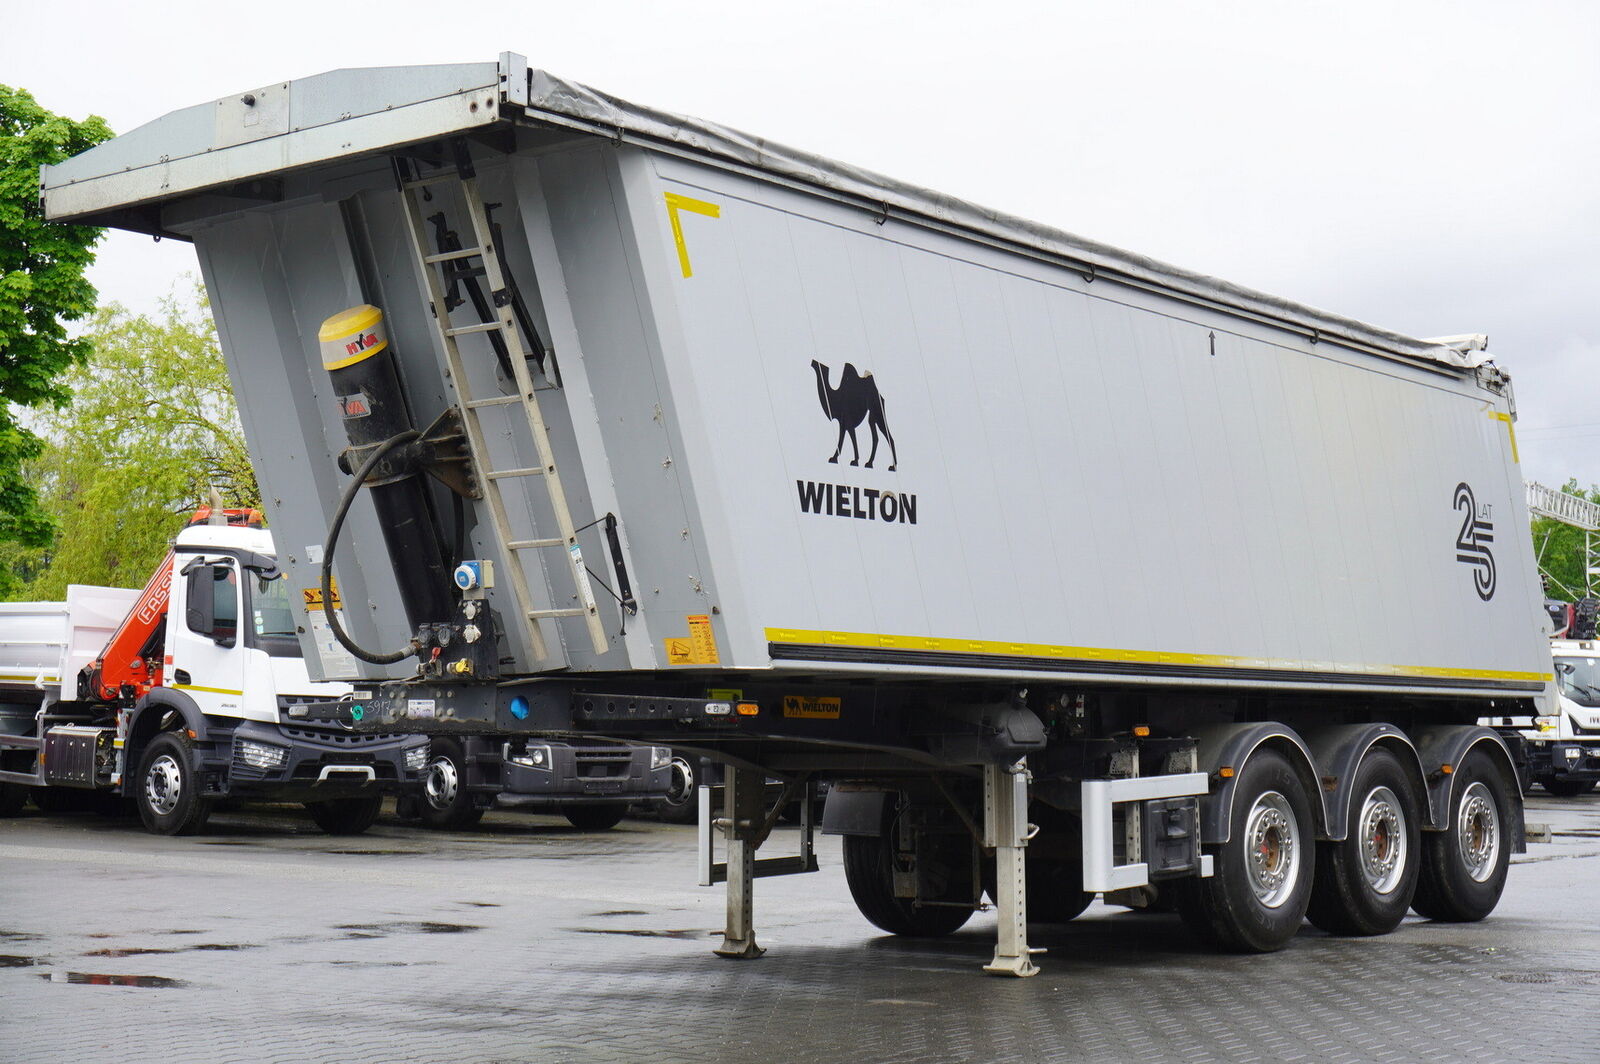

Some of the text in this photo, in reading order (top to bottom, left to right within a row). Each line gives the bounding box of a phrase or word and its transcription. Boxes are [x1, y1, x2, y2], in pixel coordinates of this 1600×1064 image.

[796, 479, 918, 525] WIELTON
[1476, 502, 1493, 520] LAT
[802, 702, 839, 713] WIELTON
